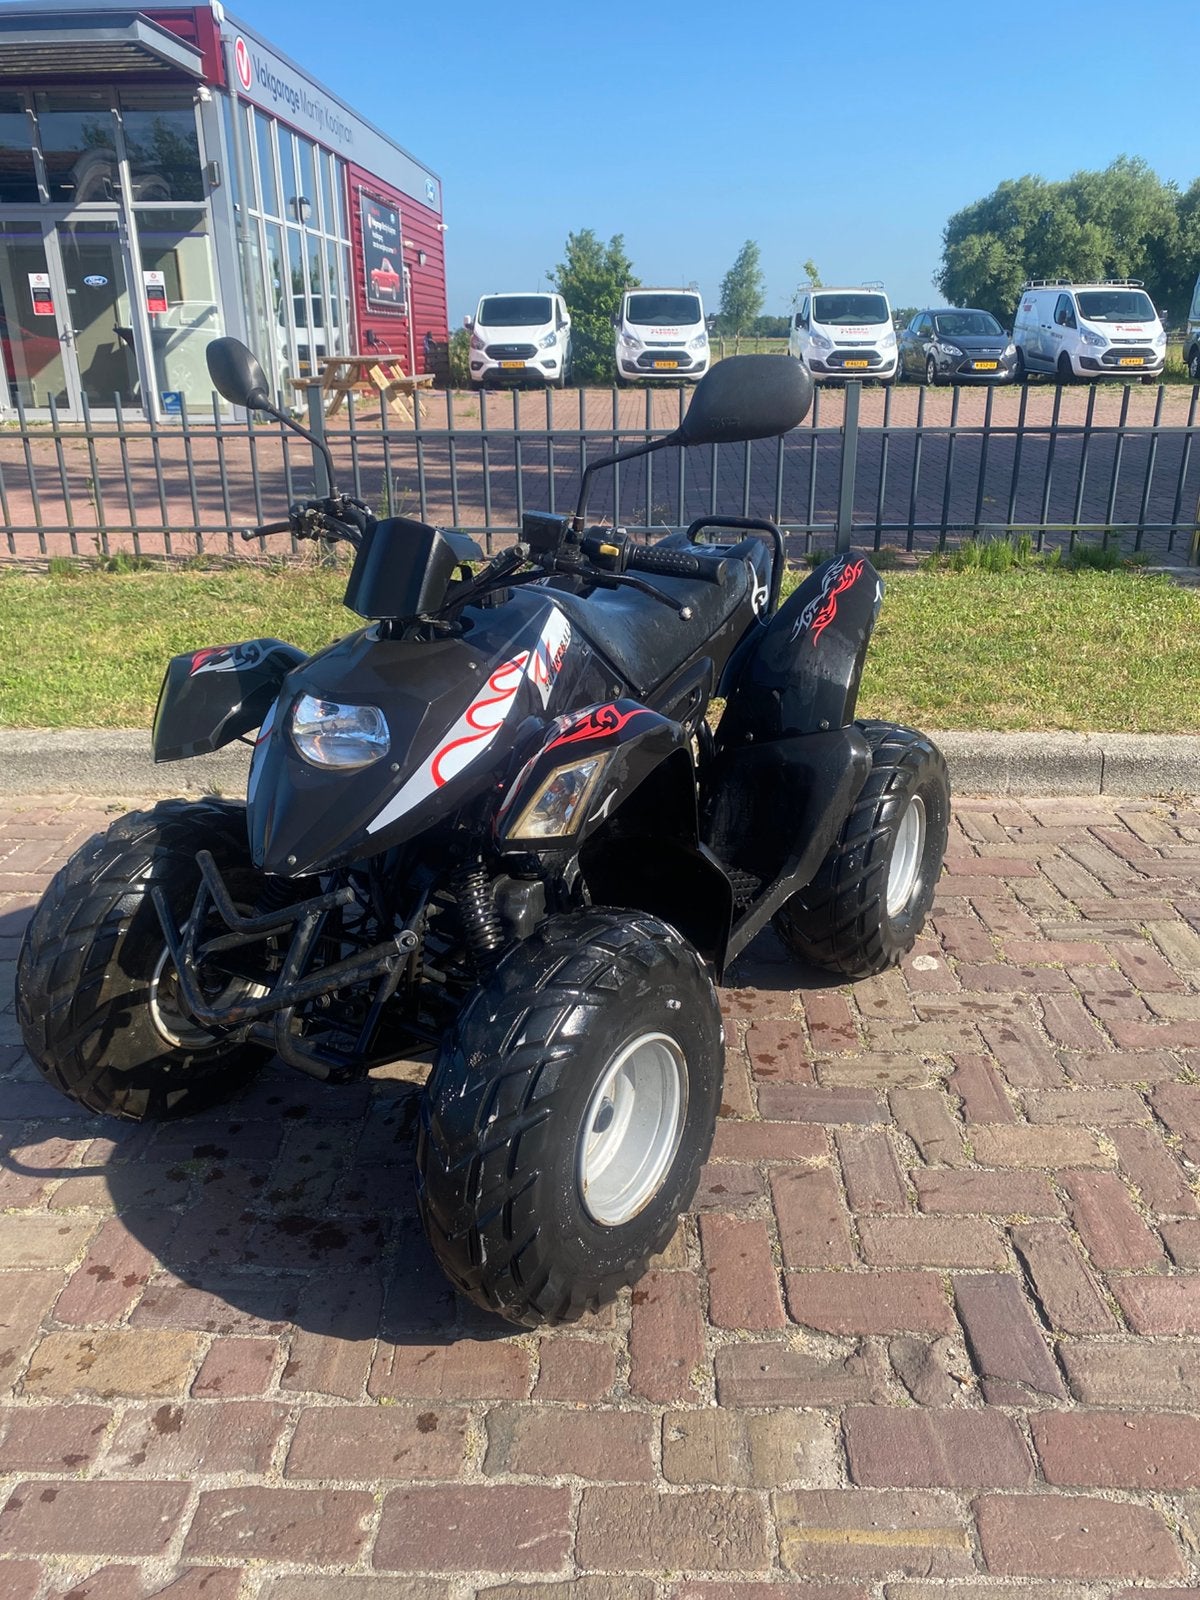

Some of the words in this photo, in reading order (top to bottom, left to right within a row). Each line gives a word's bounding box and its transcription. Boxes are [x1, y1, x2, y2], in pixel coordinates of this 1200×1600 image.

[252, 55, 300, 113] Vakgarage
[300, 89, 324, 129] Martijn
[325, 110, 353, 143] Kooijman
